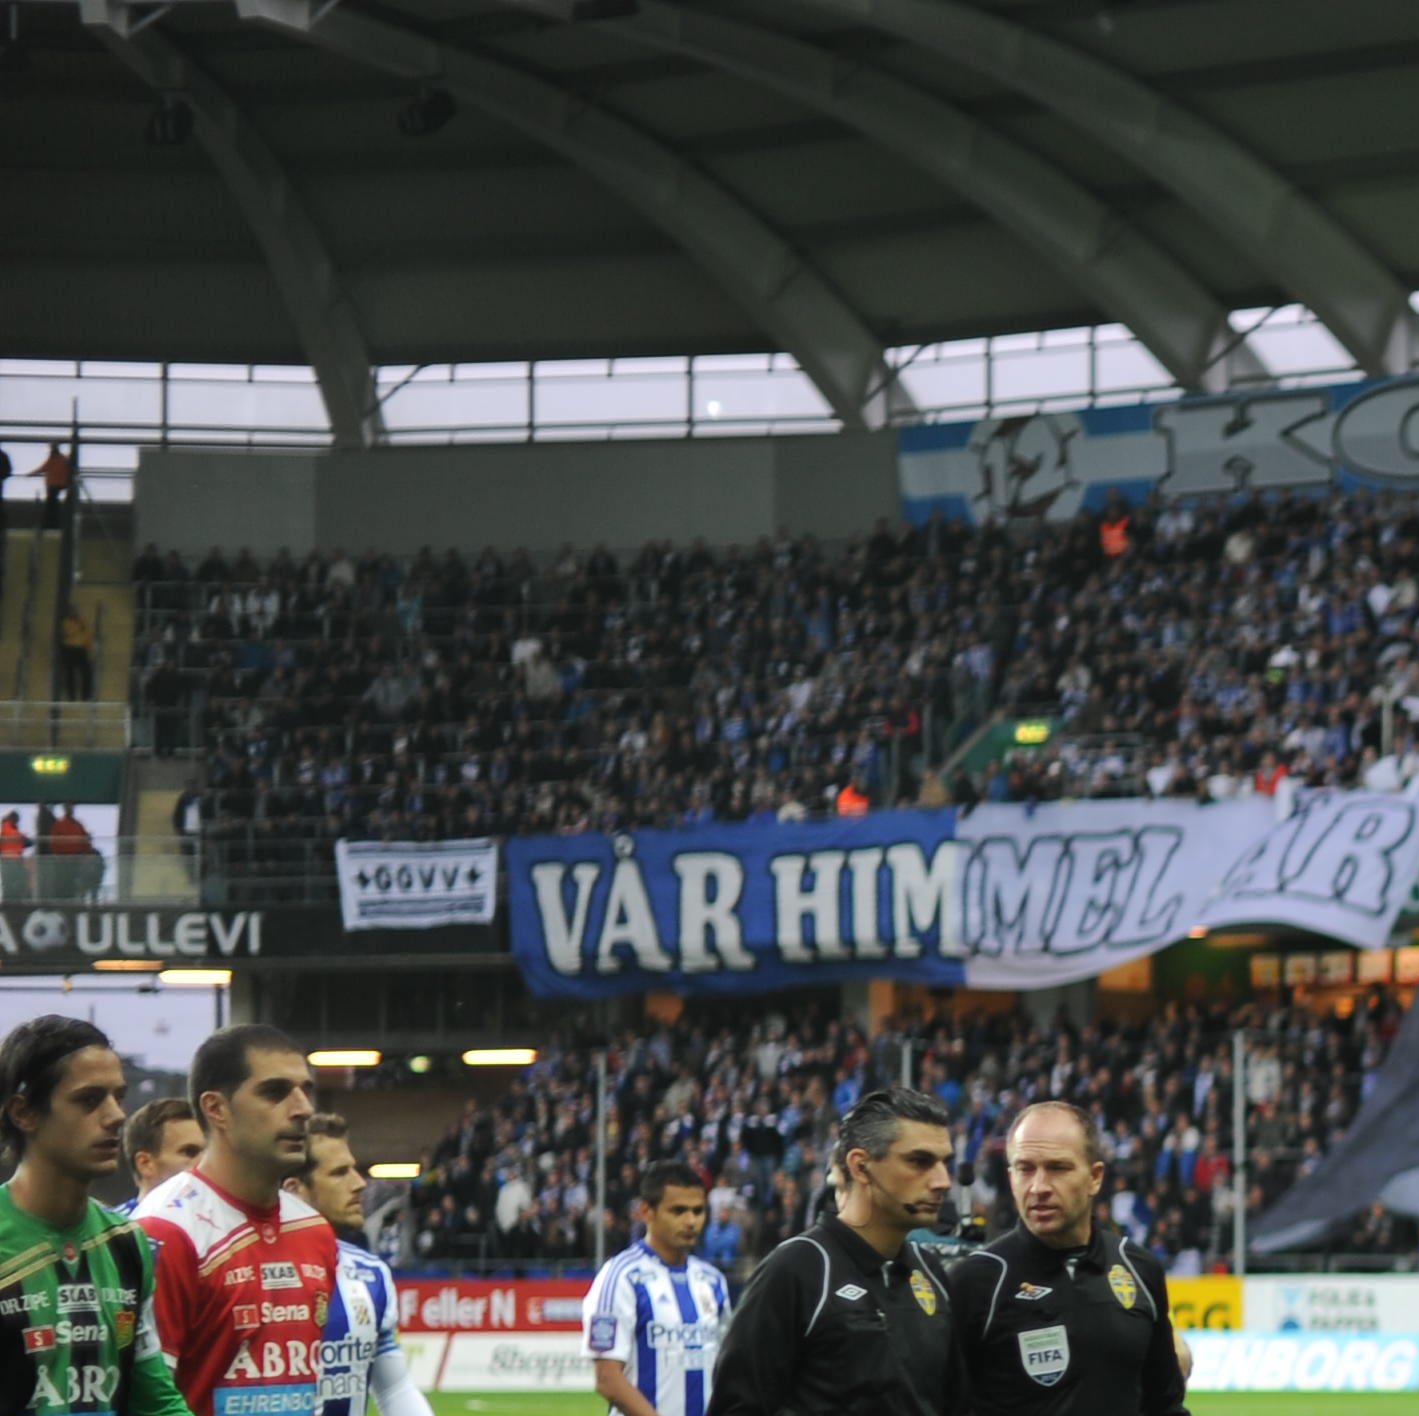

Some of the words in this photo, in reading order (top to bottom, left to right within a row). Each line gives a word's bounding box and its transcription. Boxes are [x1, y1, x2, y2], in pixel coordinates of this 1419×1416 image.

[531, 836, 757, 976] VÅR
[770, 826, 1184, 962] HIMMEL
[76, 911, 262, 955] ULLEVI
[1028, 1349, 1063, 1366] FIFA
